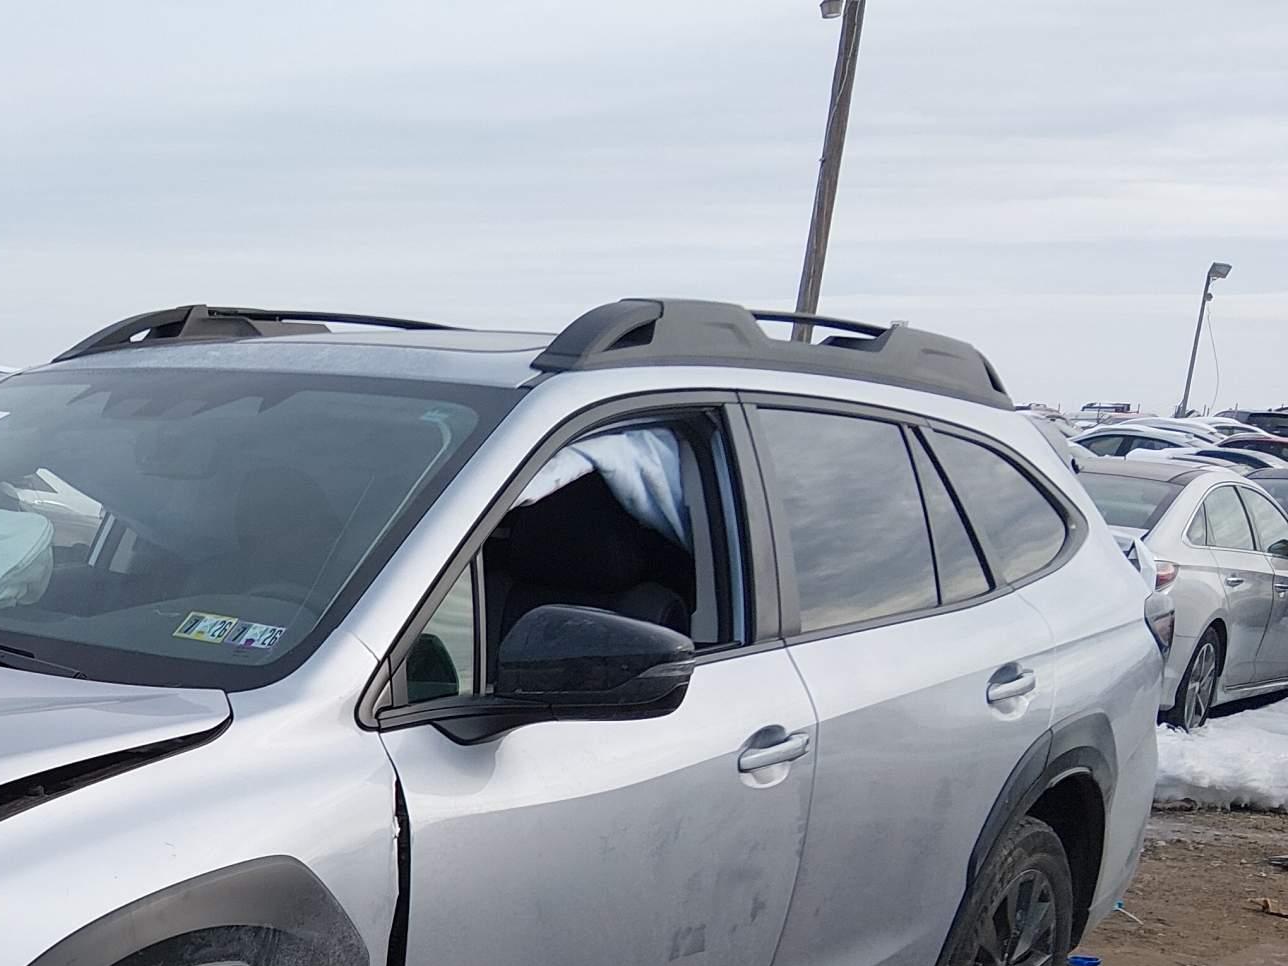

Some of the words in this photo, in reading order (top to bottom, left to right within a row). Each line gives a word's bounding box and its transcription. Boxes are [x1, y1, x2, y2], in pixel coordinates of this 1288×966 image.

[183, 617, 201, 634] 7
[210, 619, 233, 639] 26
[231, 625, 248, 642] 7
[260, 627, 282, 647] 26
